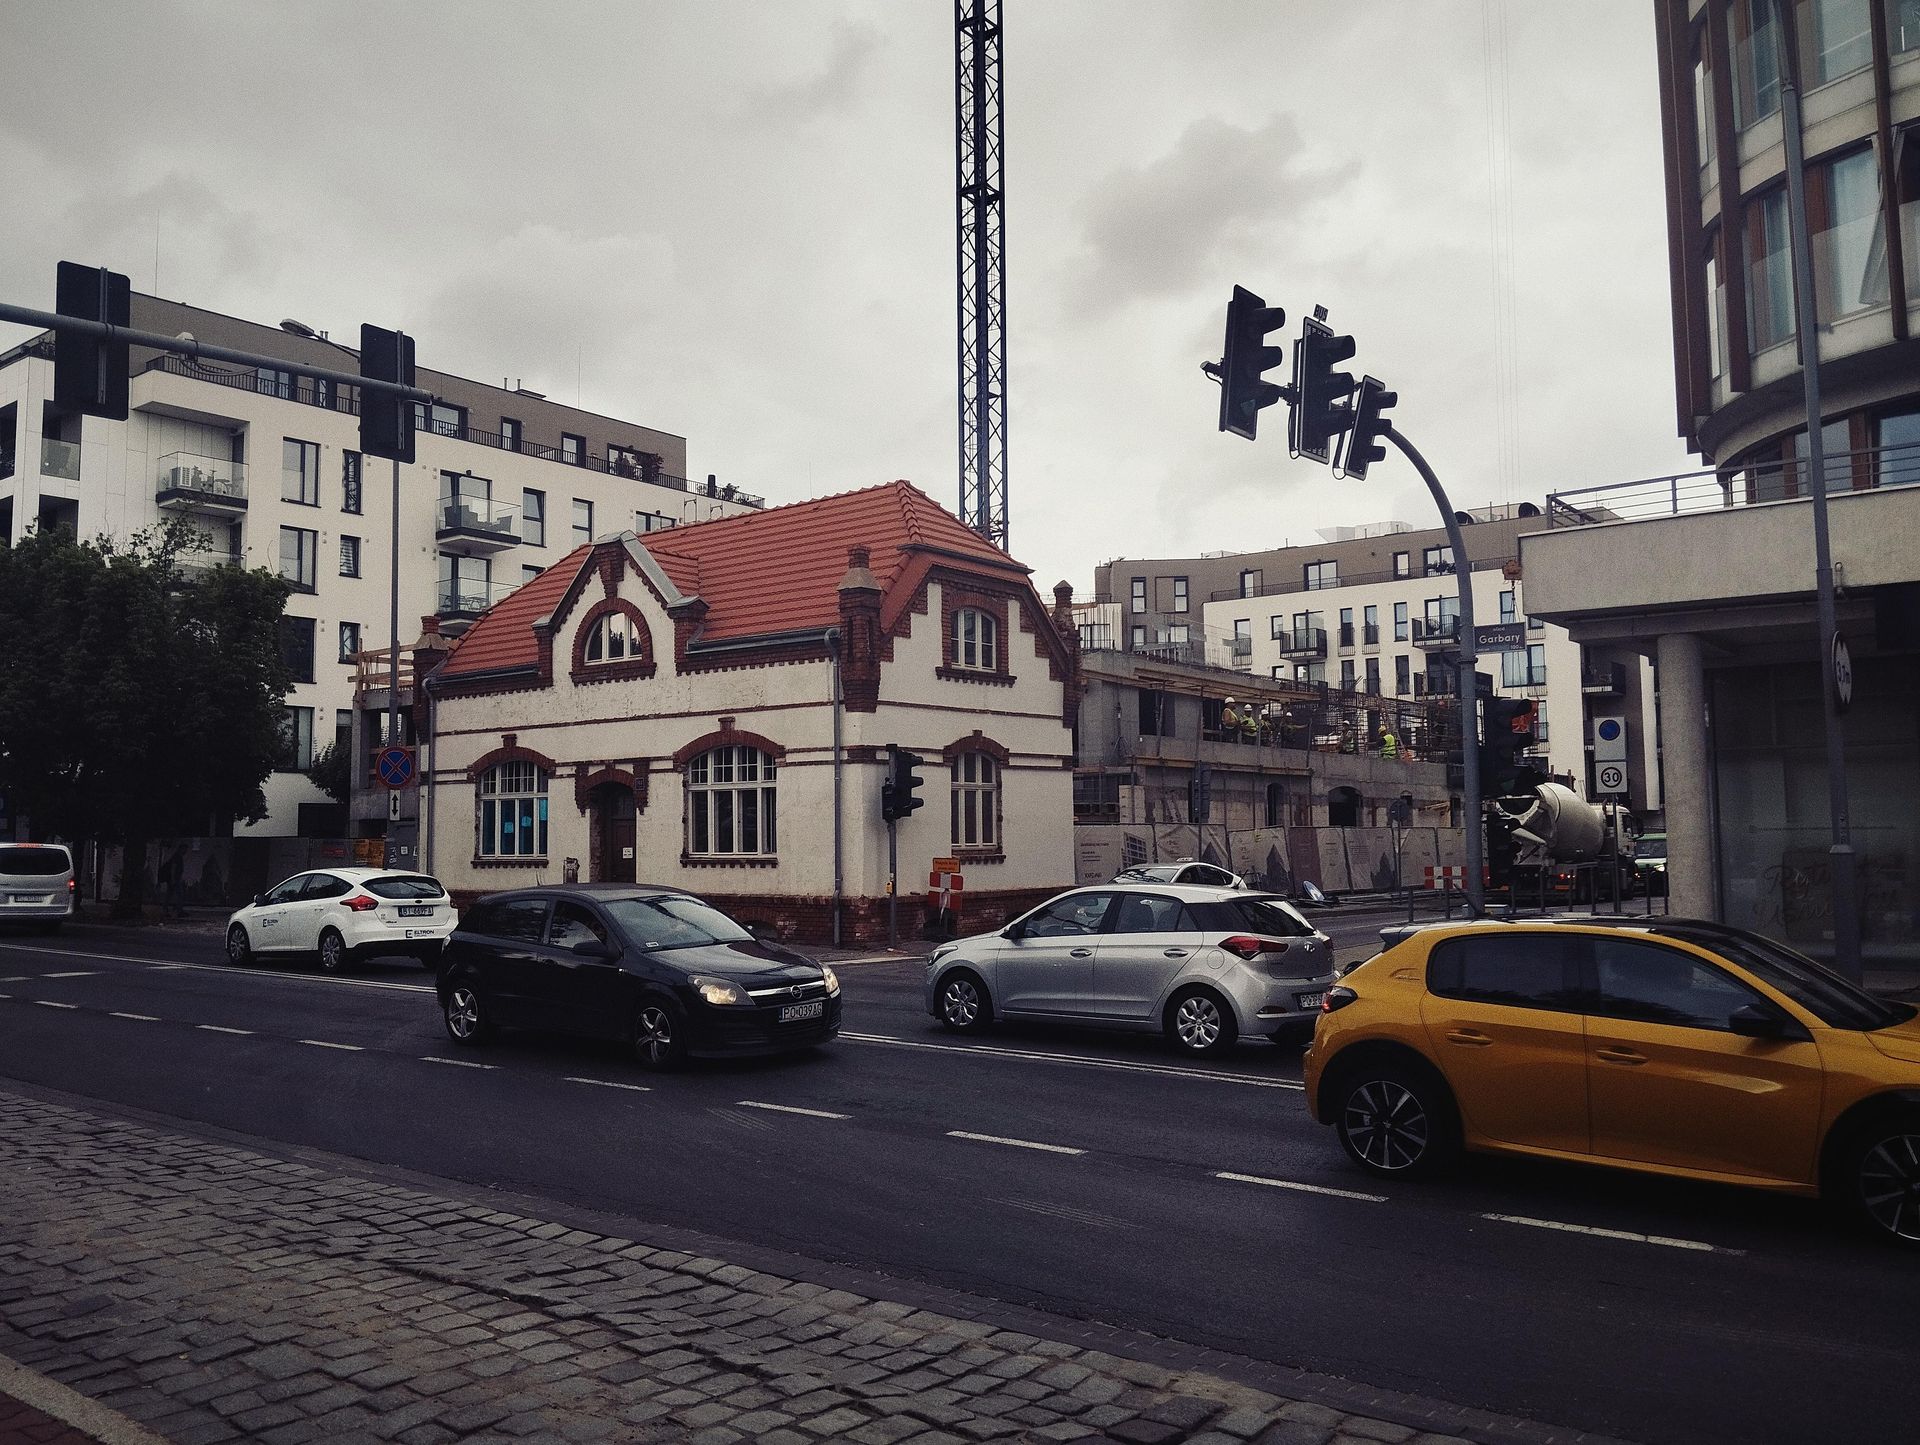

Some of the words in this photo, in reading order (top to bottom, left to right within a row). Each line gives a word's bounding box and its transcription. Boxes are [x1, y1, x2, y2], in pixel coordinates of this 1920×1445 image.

[1315, 304, 1328, 320] BUS
[1479, 634, 1520, 645] Garbary
[1604, 772, 1619, 783] 30
